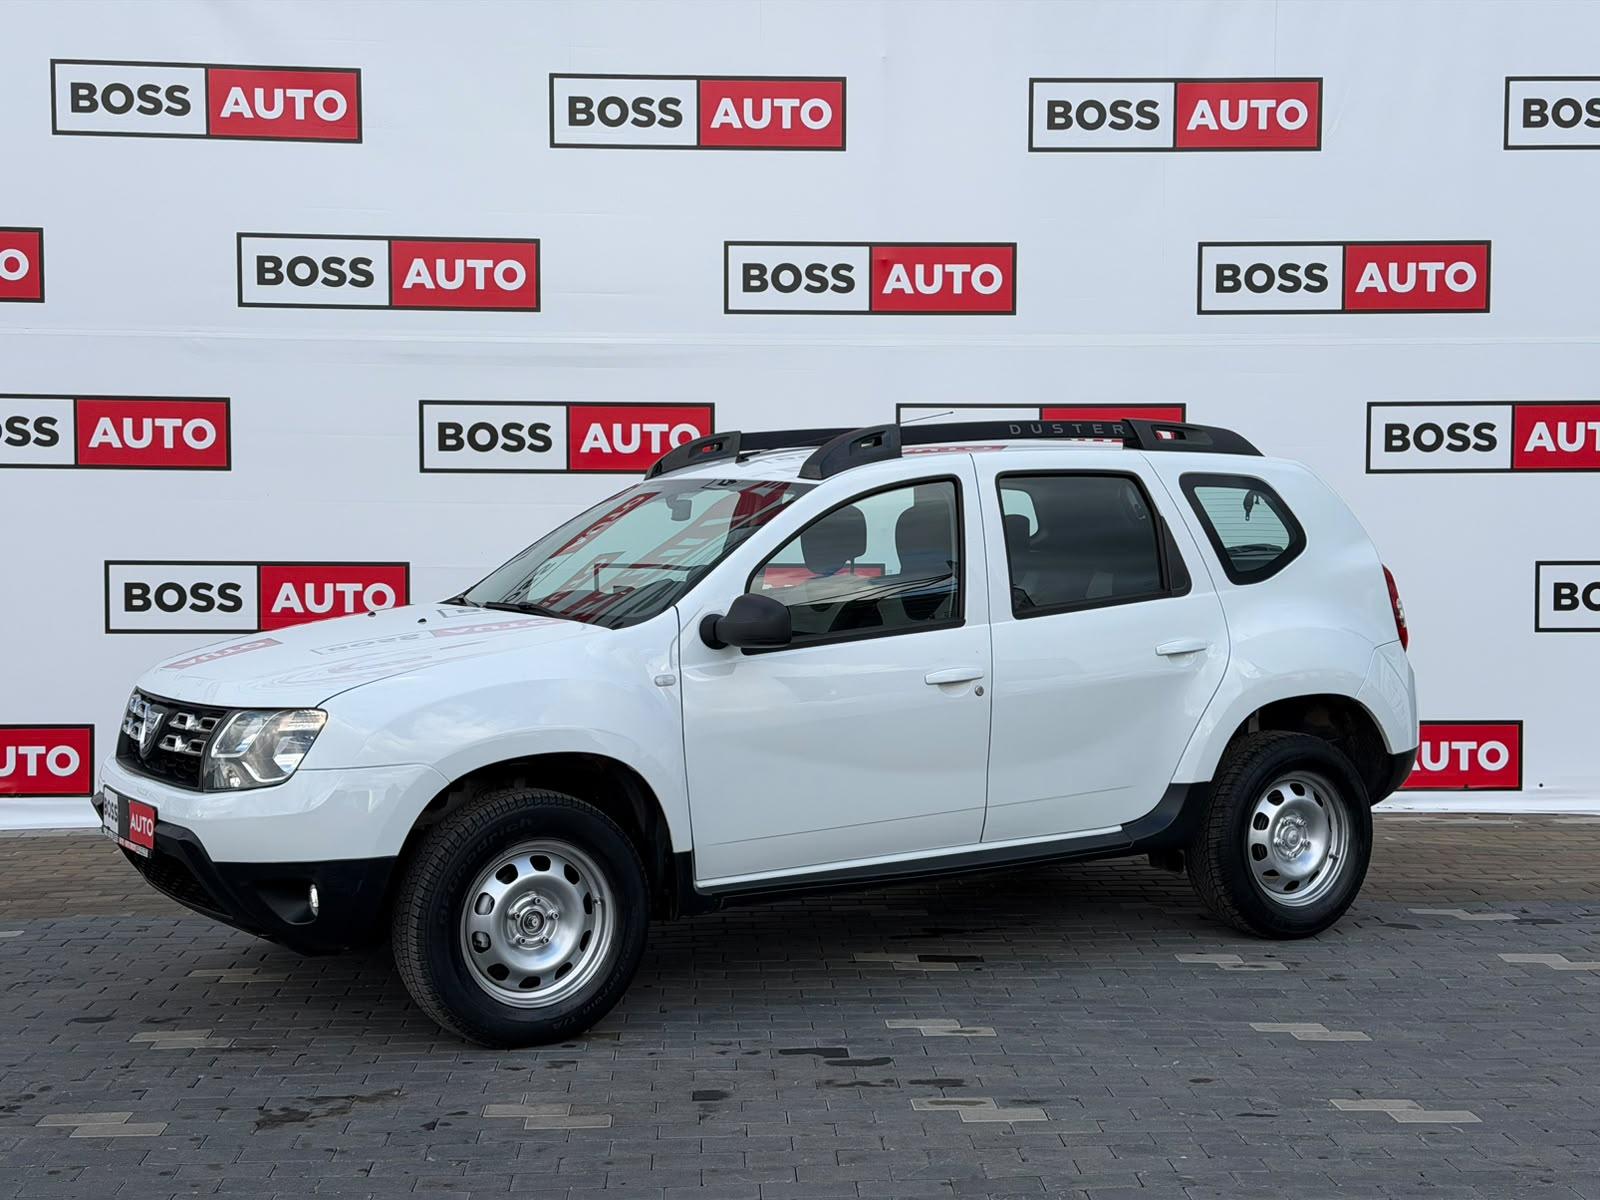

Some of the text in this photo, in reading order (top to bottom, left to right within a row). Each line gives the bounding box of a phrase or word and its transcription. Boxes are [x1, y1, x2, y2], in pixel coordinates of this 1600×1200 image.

[70, 82, 348, 122] BOSS AUTO
[568, 95, 833, 130] BOSS AUTO
[1046, 98, 1309, 131] BOSS AUTO
[256, 255, 527, 291] BOSS AUTO
[742, 262, 1003, 295] BOSS AUTO
[1215, 261, 1477, 294] BOSS AUTO
[0, 415, 217, 450] SS AUTO
[437, 421, 701, 454] BOSS AUTO
[1009, 423, 1125, 435] DUSTER
[1384, 422, 1498, 453] BOSS
[124, 581, 396, 613] BOSS AUTO
[1411, 740, 1509, 772] UTO
[103, 796, 155, 838] BOSS AUTO
